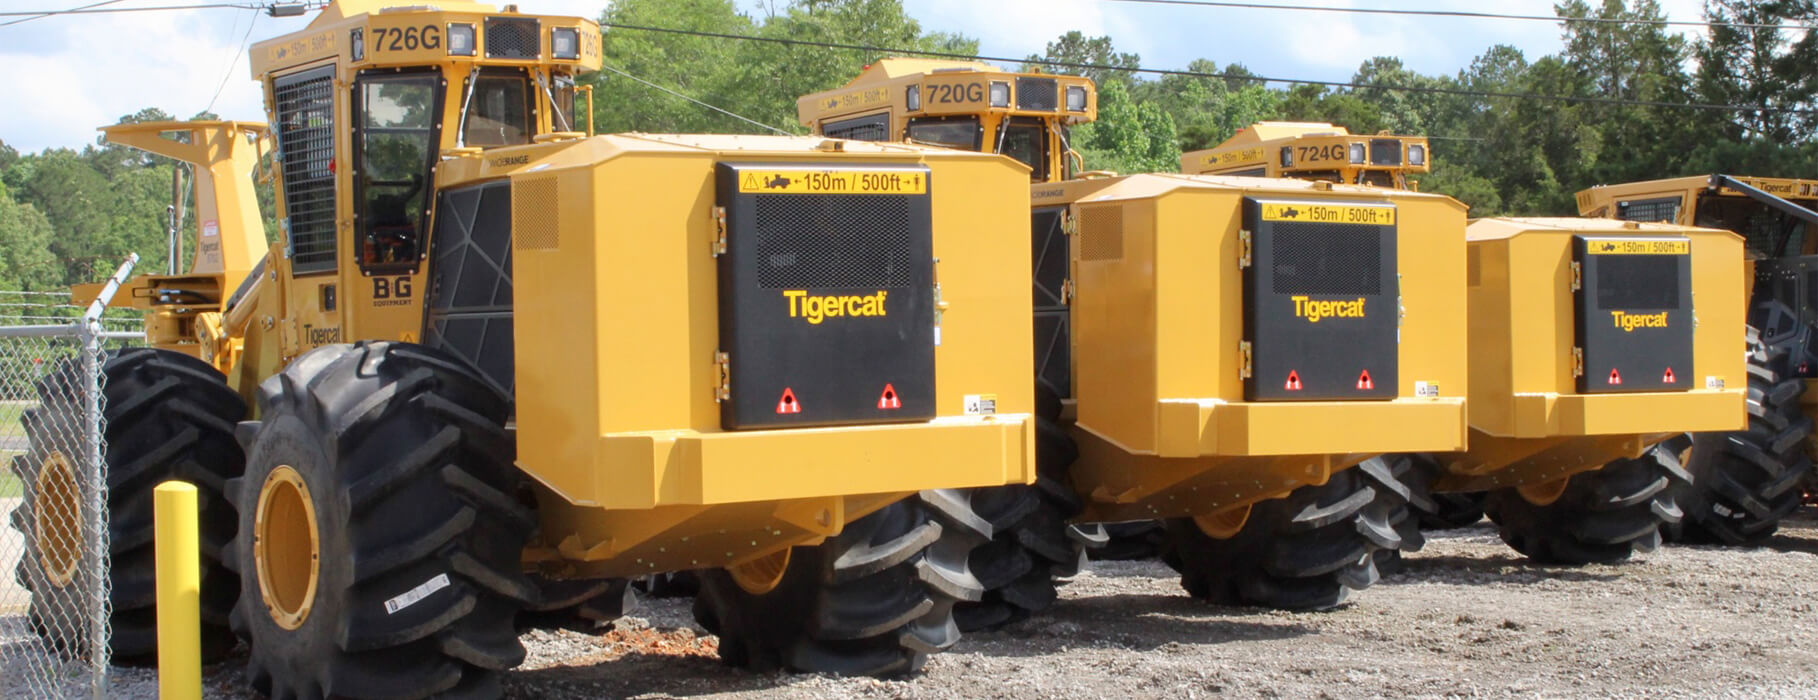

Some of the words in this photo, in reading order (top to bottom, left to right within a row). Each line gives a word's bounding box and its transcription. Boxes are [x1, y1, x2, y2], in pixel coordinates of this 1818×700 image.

[372, 25, 441, 52] 726G
[842, 95, 859, 107] 150m
[926, 83, 983, 104] 720G
[1222, 152, 1237, 163] 150m
[1298, 144, 1345, 162] 724G
[804, 173, 847, 191] 150m
[851, 173, 857, 191] /
[862, 173, 902, 191] 500ft
[1760, 182, 1792, 194] Tigercat
[1308, 206, 1338, 220] 150m
[1348, 208, 1377, 222] 500ft
[1622, 242, 1646, 252] 150m
[1653, 242, 1675, 252] 500ft
[783, 290, 887, 325] Tigercat
[1291, 295, 1366, 322] Tigercat
[1611, 310, 1668, 331] Tigercat
[304, 324, 341, 348] Tigercat
